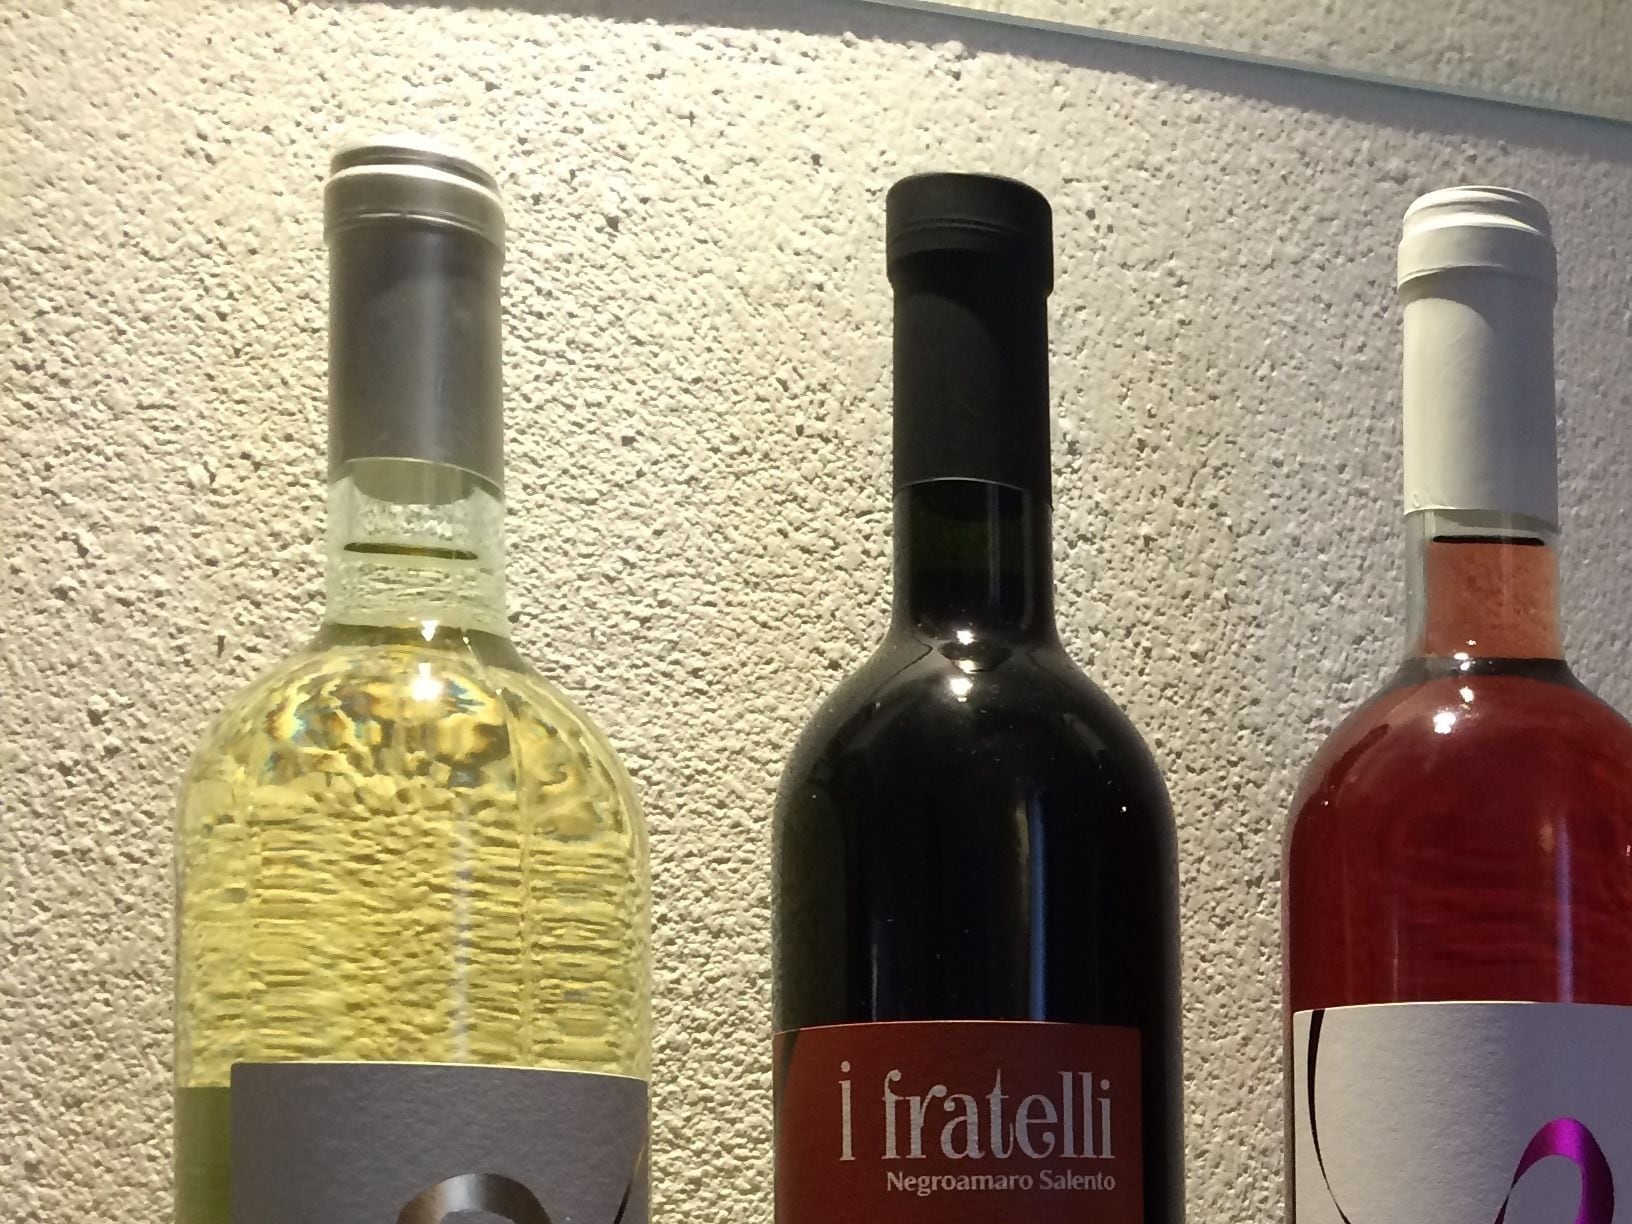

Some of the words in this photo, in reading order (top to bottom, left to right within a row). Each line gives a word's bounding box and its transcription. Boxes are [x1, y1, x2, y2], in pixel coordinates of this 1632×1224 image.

[838, 1060, 856, 1161] i
[881, 1068, 1116, 1160] fratelli
[887, 1171, 1034, 1196] Negroamaro
[1039, 1170, 1117, 1191] Salento
